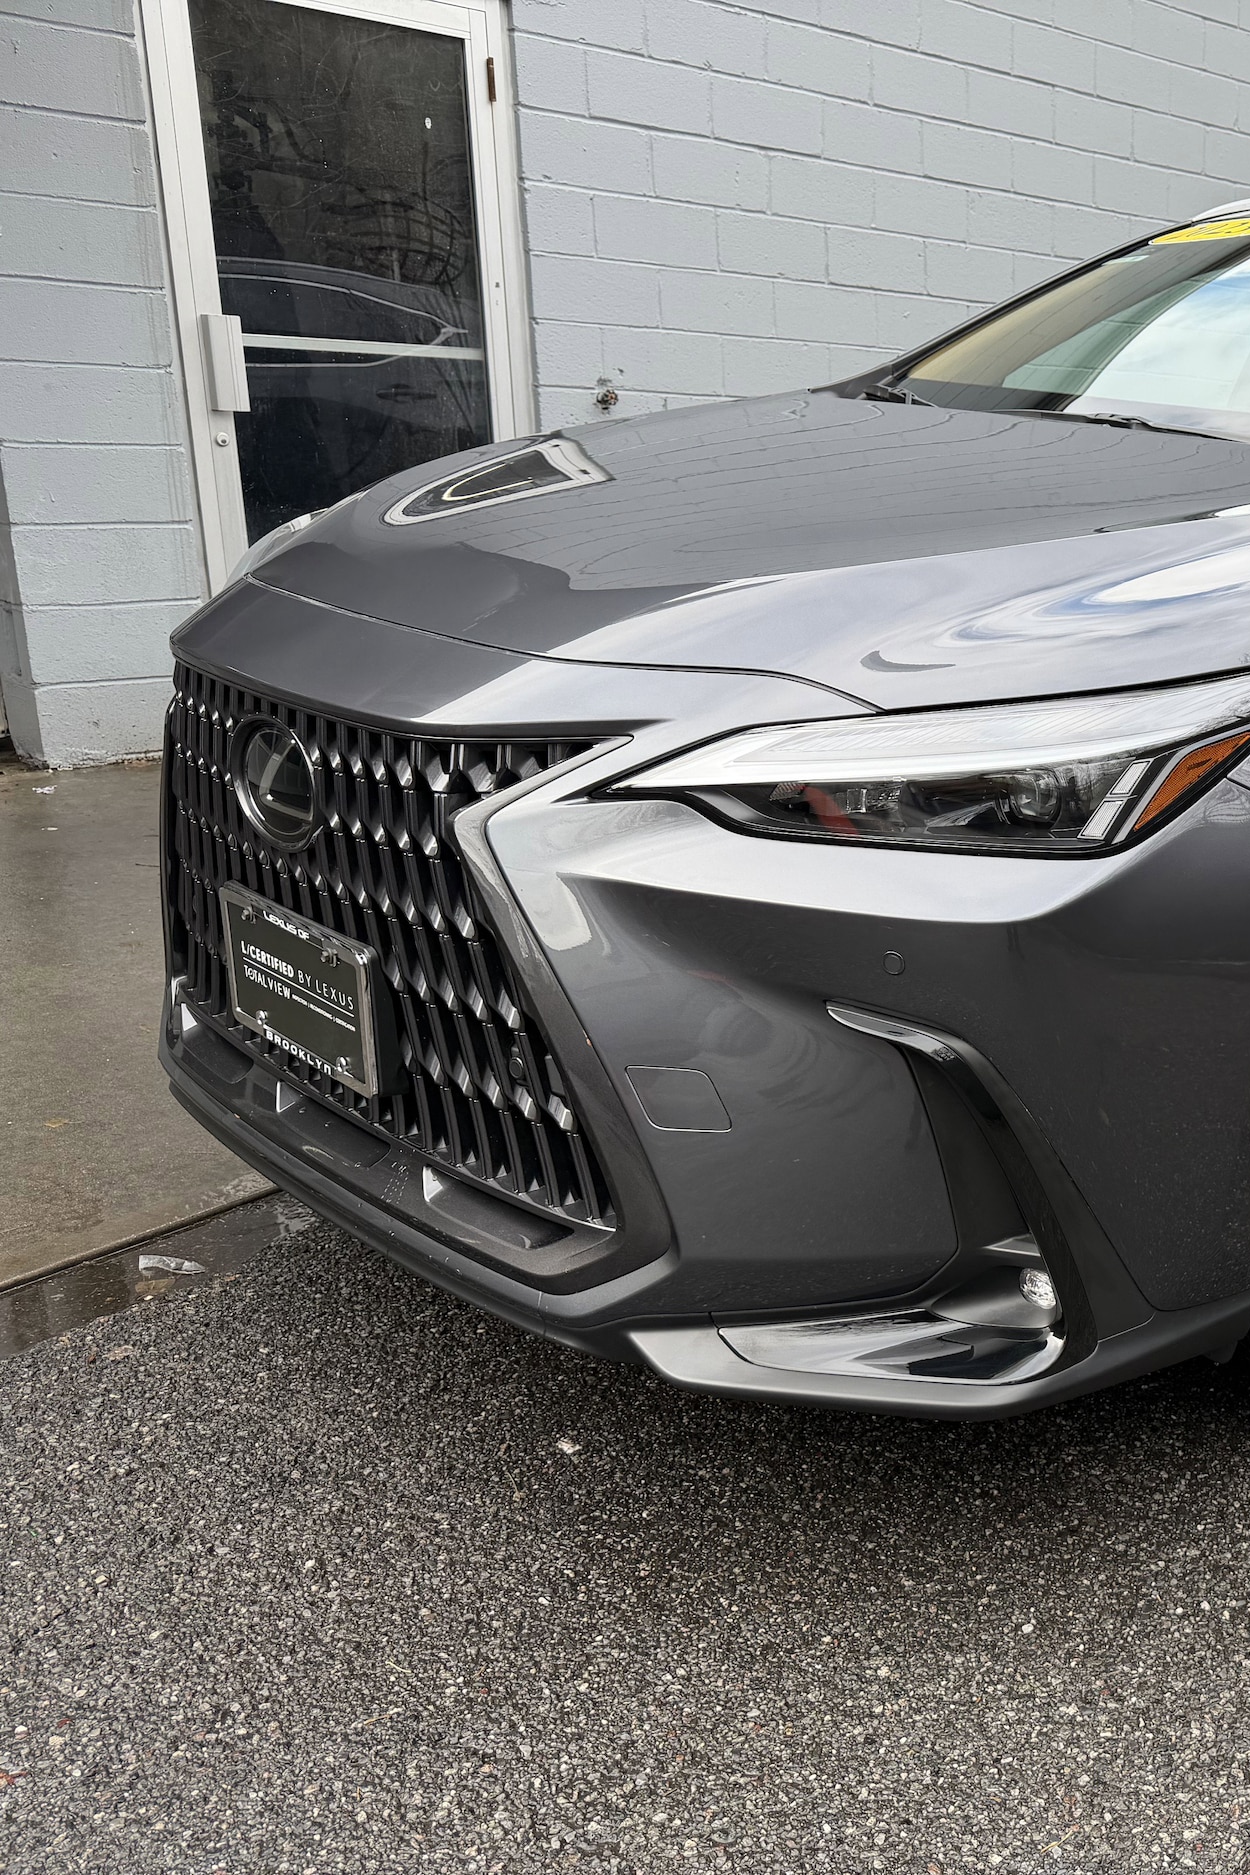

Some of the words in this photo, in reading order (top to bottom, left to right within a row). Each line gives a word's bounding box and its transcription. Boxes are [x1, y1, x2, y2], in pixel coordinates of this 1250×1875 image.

[263, 910, 298, 936] LEXUS
[296, 928, 310, 940] OF
[240, 940, 295, 978] L/CERTIFIED
[297, 969, 313, 988] BY
[315, 980, 355, 1011] LEXUS
[265, 1029, 332, 1076] BROOKLYN
